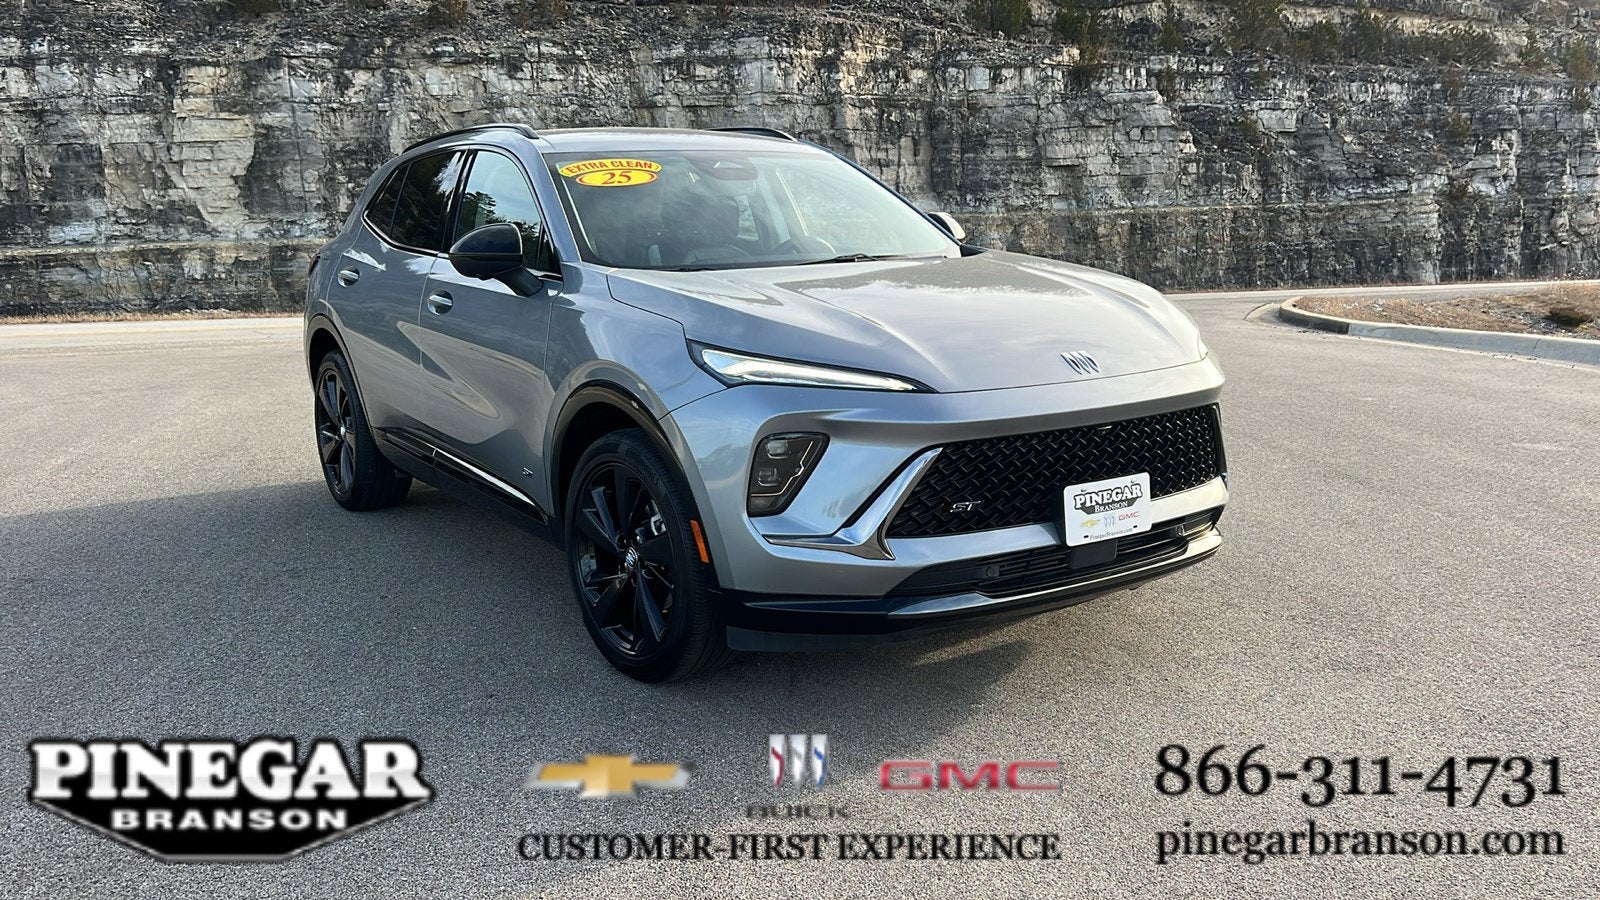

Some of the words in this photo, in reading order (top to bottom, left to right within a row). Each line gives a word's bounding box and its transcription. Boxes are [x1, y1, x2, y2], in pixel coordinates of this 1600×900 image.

[566, 162, 608, 174] EXTRA
[611, 160, 652, 169] CLEAN
[601, 170, 632, 185] 25
[1074, 483, 1143, 509] PINEGAR
[1094, 501, 1128, 513] BRANSON
[1118, 511, 1140, 521] GMC
